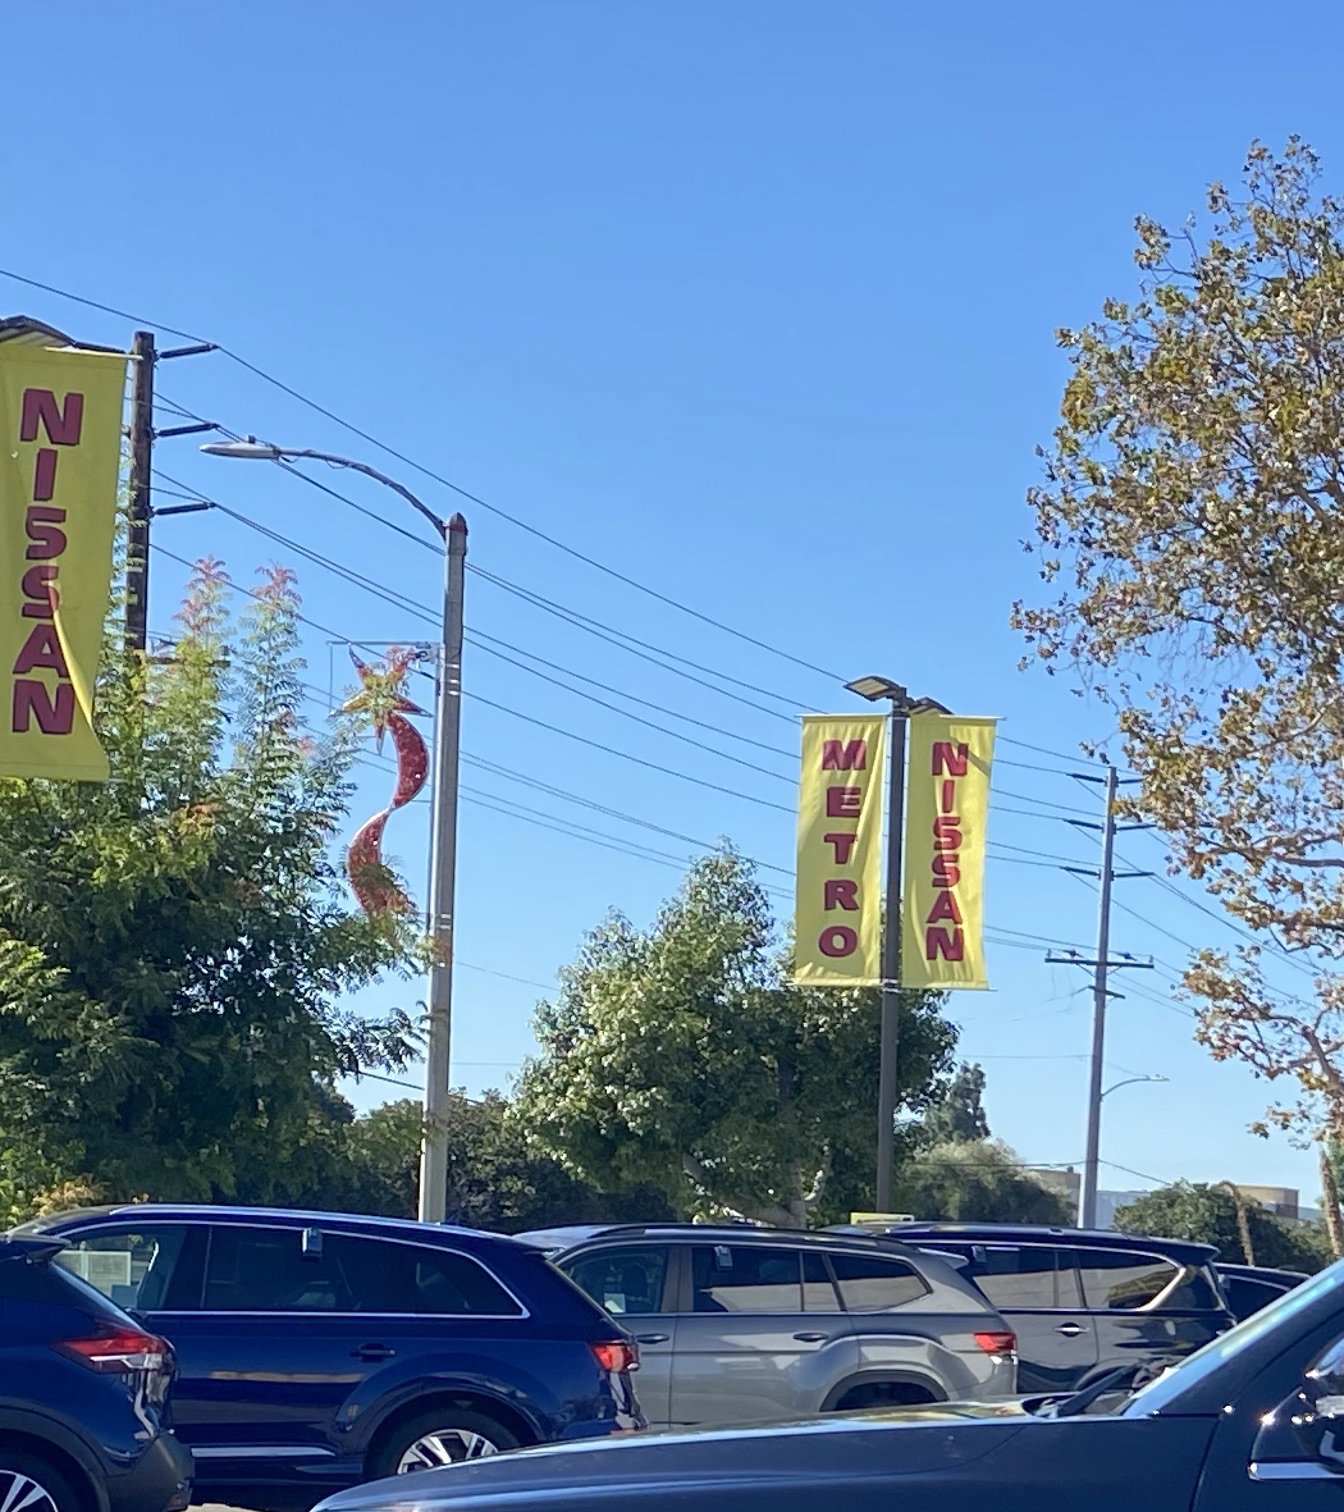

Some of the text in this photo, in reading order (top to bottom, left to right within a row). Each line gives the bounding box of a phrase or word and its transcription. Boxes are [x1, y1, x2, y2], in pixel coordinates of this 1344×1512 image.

[12, 387, 84, 734] NISSAN
[818, 739, 867, 958] METRO
[926, 741, 969, 961] NISSAN
